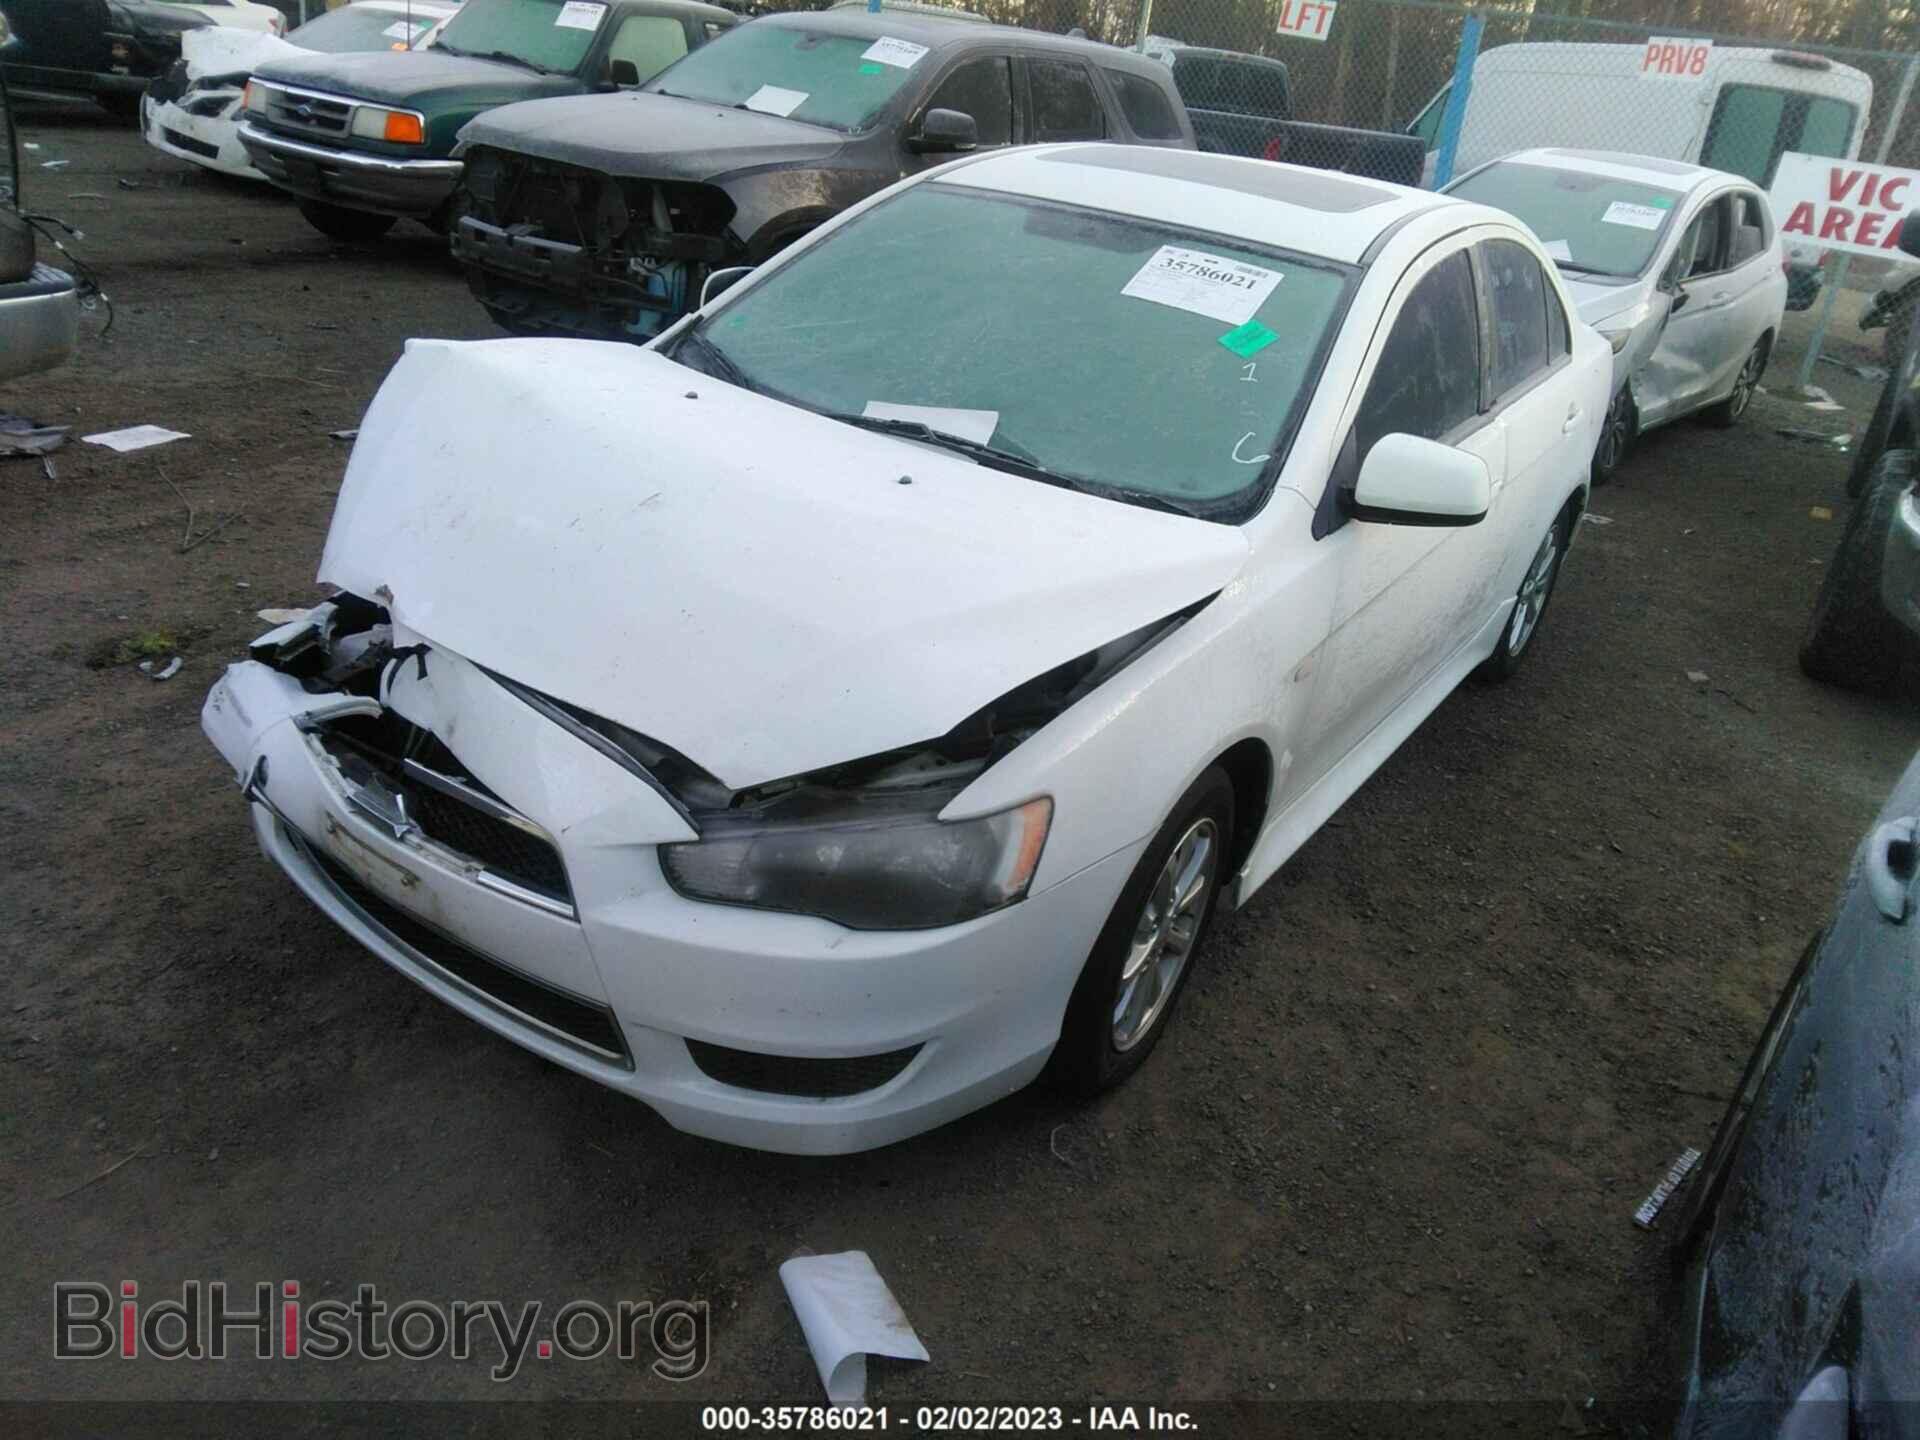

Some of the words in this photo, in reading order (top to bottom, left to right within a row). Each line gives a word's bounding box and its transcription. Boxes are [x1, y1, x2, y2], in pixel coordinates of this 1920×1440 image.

[1280, 0, 1333, 34] LFT
[1643, 44, 1709, 75] PRV8
[1829, 167, 1911, 211] VIC
[1159, 257, 1257, 290] 35786021
[1239, 362, 1258, 382] 1
[1231, 431, 1271, 464] 6
